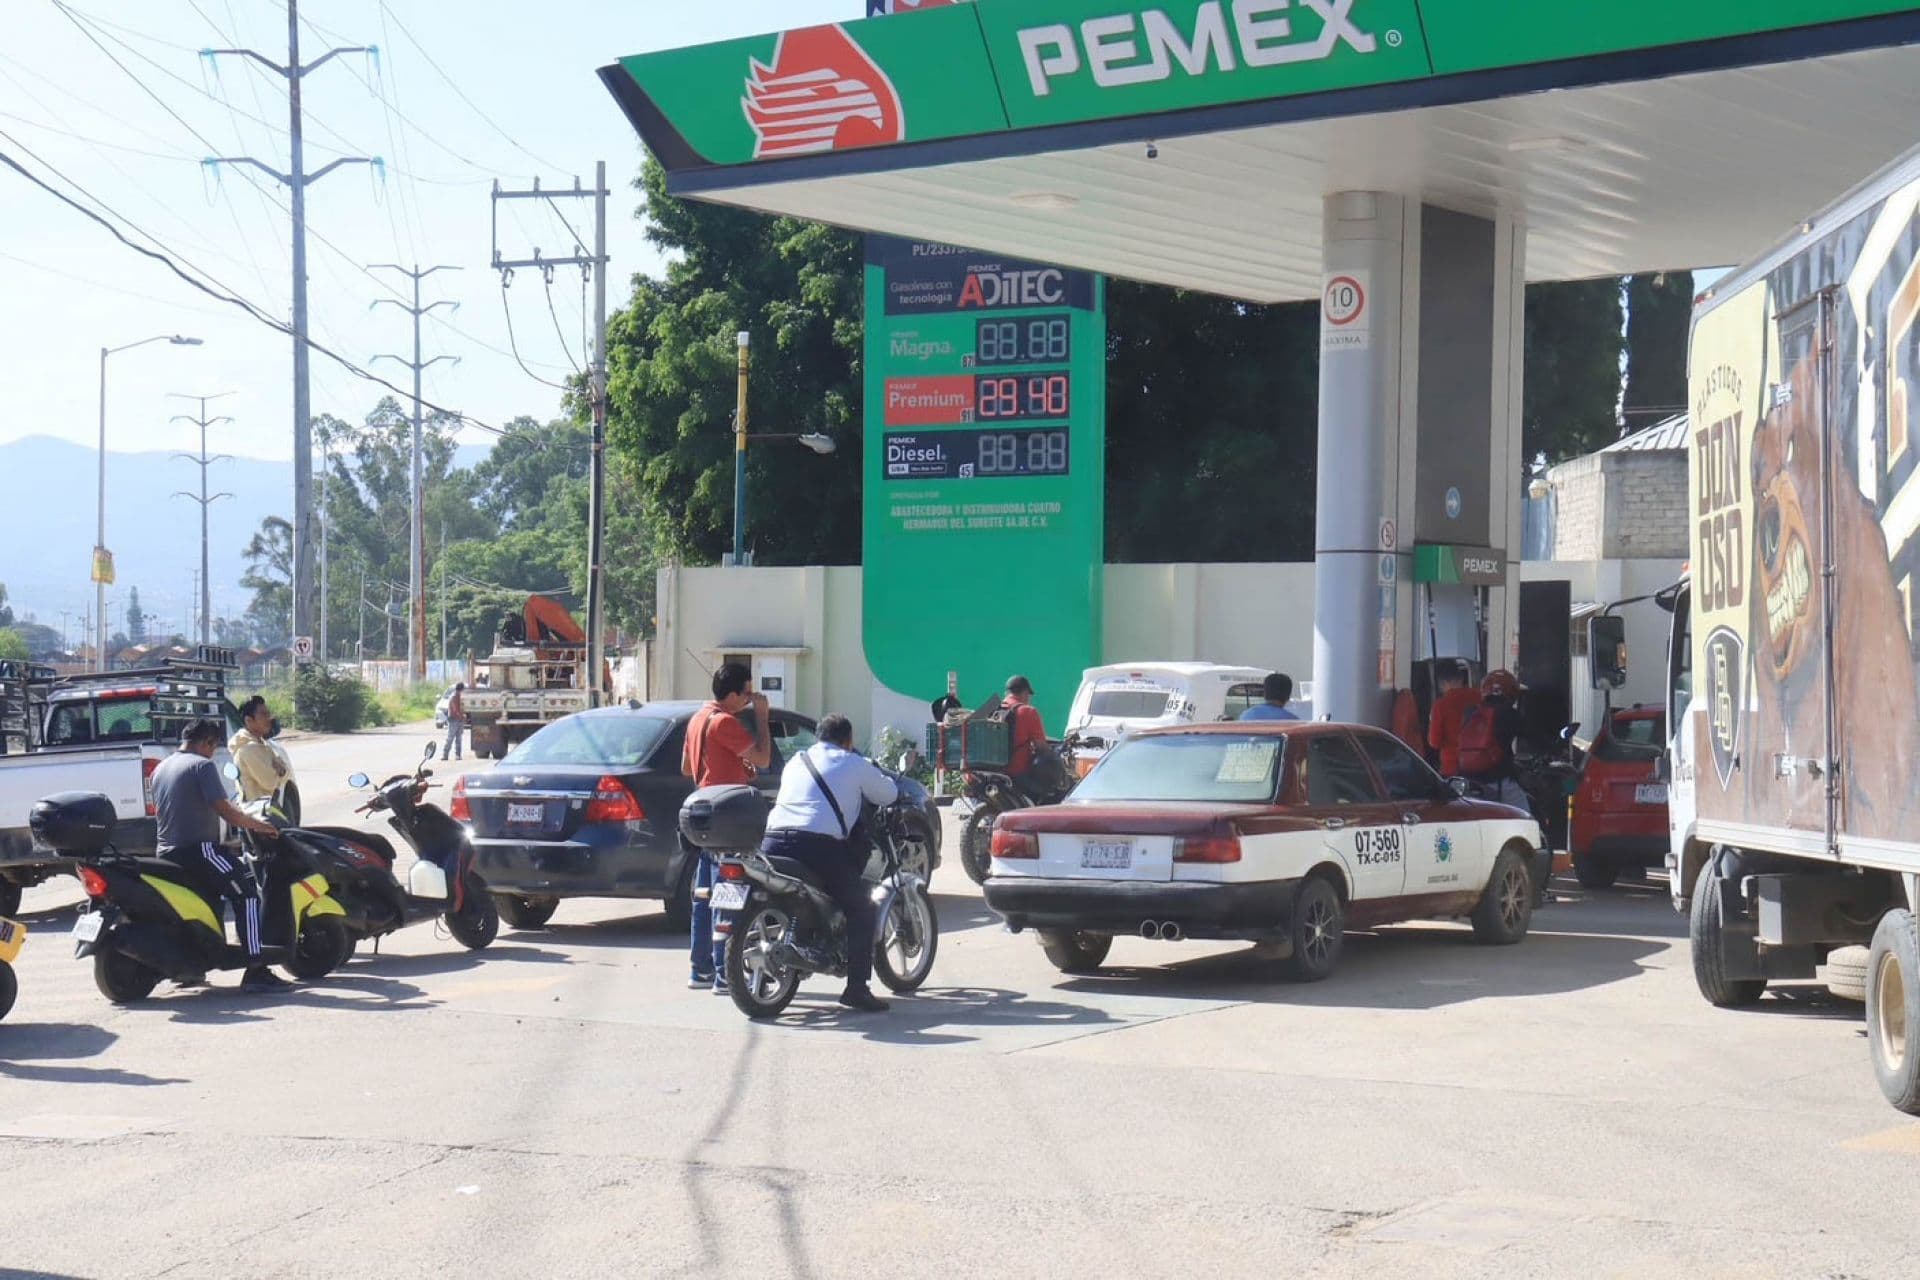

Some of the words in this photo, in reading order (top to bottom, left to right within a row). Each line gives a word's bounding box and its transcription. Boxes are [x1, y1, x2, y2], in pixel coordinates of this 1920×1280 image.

[1016, 0, 1376, 97] PEMEX
[1330, 287, 1353, 308] 10
[889, 339, 951, 360] Magna
[888, 390, 965, 409] Premium
[888, 444, 942, 462] Diesel
[1695, 410, 1742, 517] DON
[1463, 558, 1498, 574] PEMEX
[1699, 508, 1744, 614] OSO
[1355, 829, 1400, 853] 07-560
